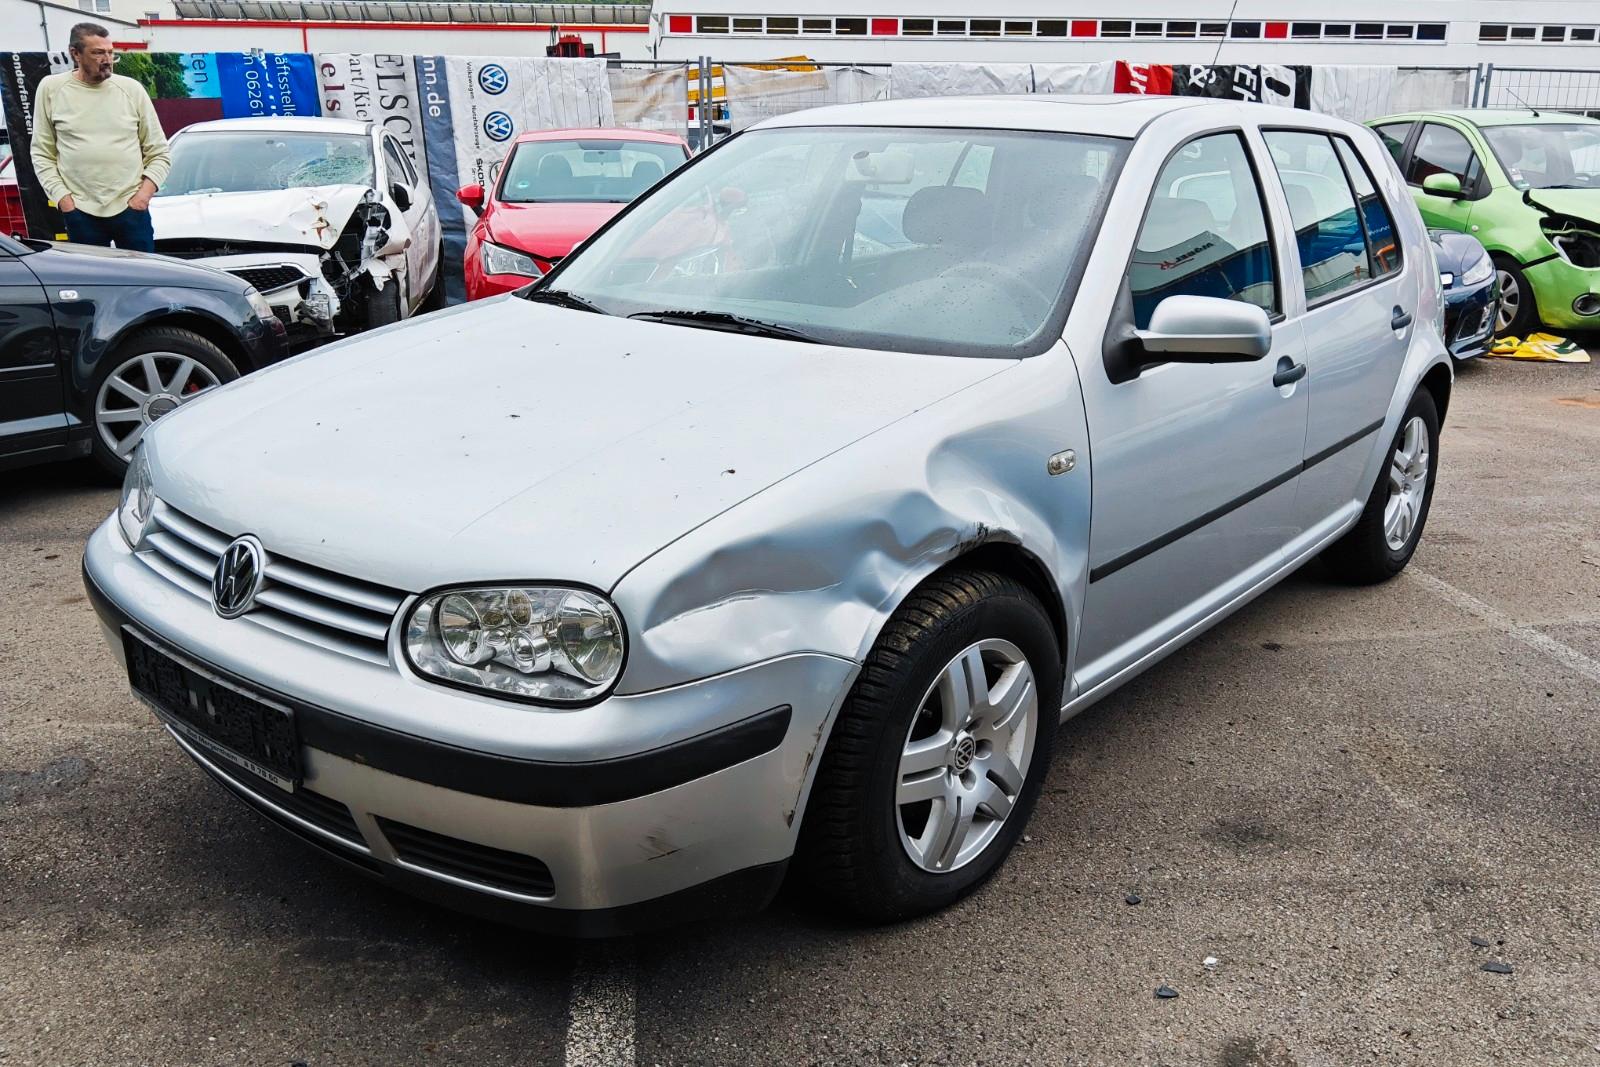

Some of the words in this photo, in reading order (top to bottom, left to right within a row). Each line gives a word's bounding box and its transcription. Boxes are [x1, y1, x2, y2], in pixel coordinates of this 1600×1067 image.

[11, 51, 33, 135] onderfahrten
[245, 71, 265, 116] 06261
[466, 61, 475, 100] Volkswagen
[471, 105, 480, 149] Nutzfahrzeuge
